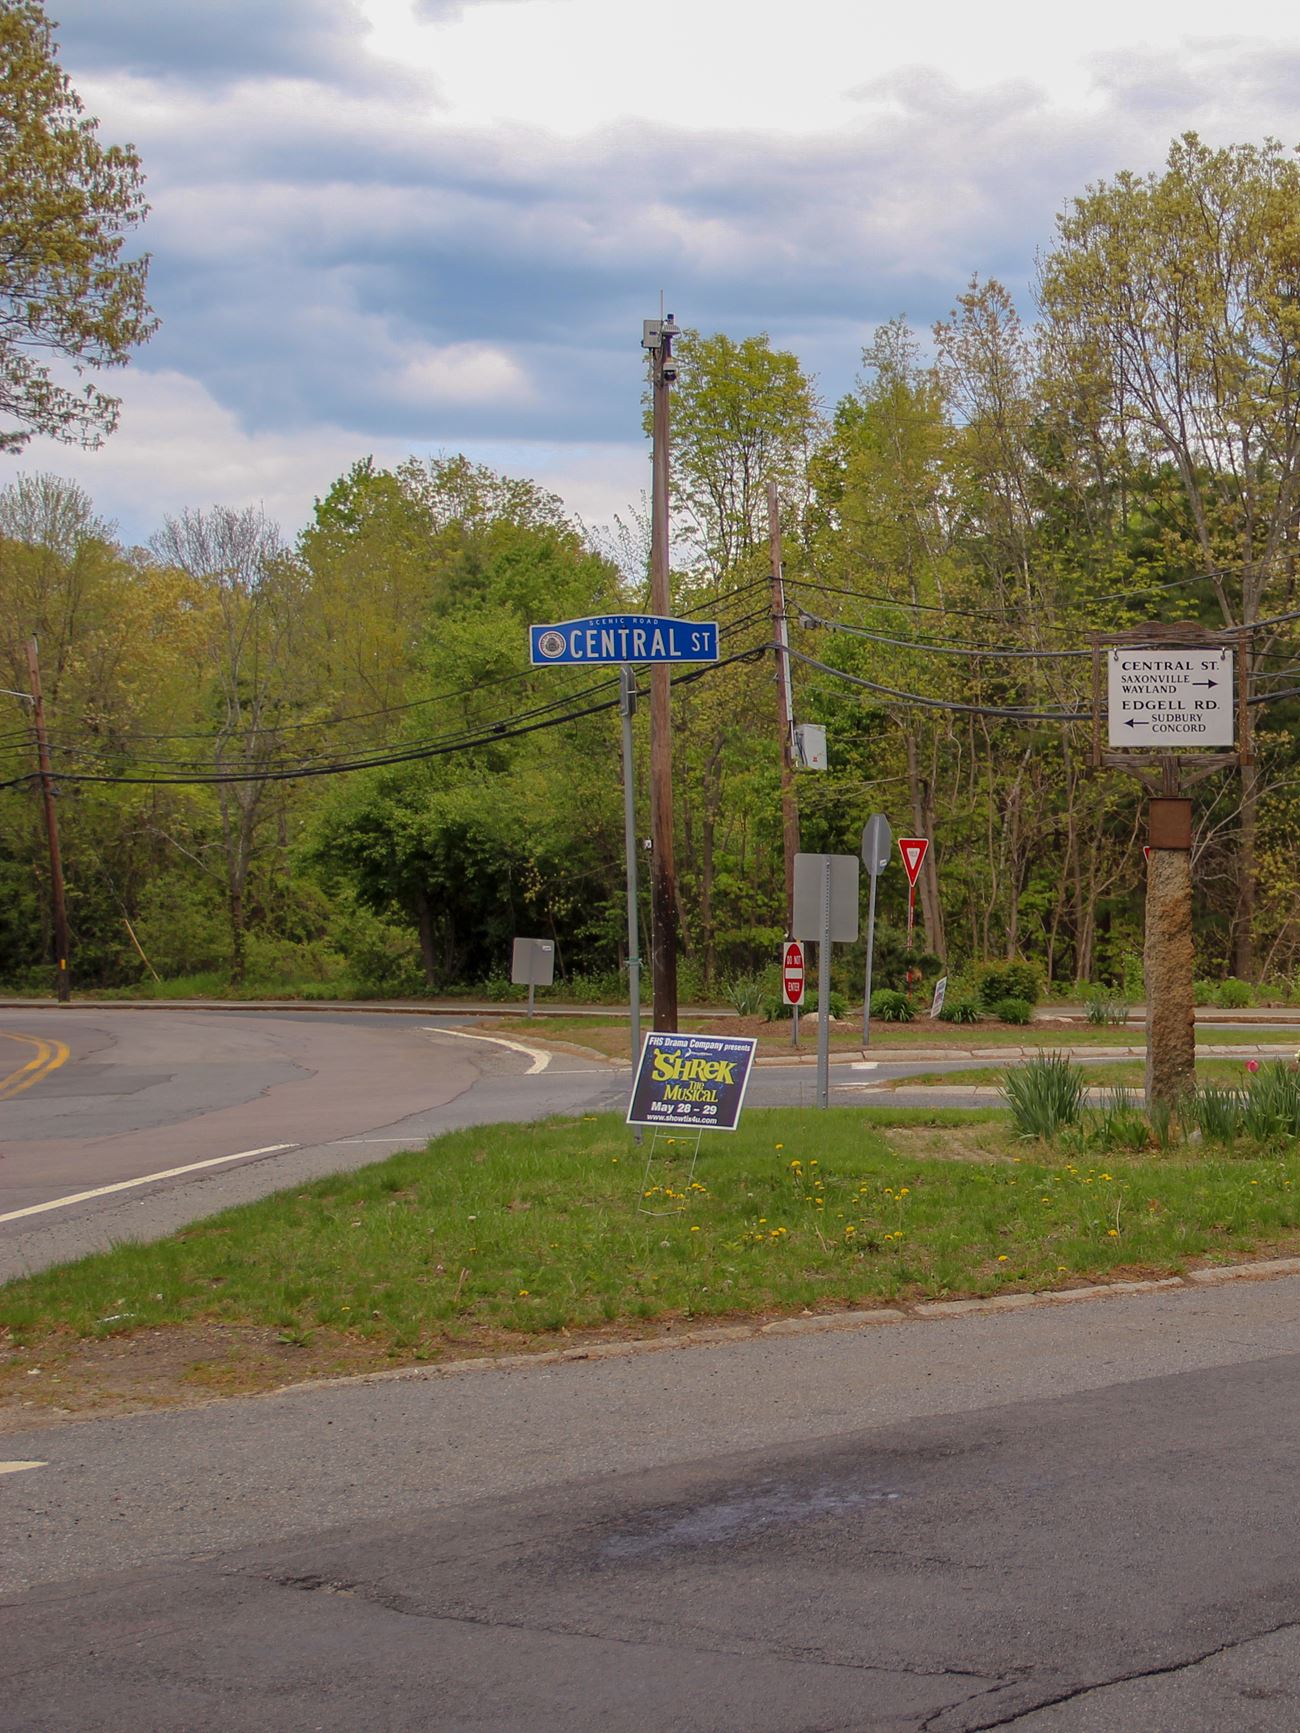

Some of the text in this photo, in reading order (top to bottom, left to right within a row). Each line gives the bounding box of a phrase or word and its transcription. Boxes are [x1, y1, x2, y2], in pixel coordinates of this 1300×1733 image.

[589, 617, 625, 626] SCENIC
[570, 629, 681, 658] CENTRAL
[691, 632, 710, 652] ST
[1122, 661, 1194, 671] CENTRAL
[1121, 675, 1190, 684] SAXONVILLE
[1122, 685, 1177, 694] WAYLAND
[1122, 700, 1220, 710] EDGELL RD.
[1152, 714, 1203, 722] SUDBURY
[1152, 724, 1206, 733] CONCORD
[649, 1036, 751, 1052] FHS Drama Company presents
[651, 1101, 674, 1115] May
[677, 1103, 691, 1113] 28
[702, 1105, 717, 1115] 29
